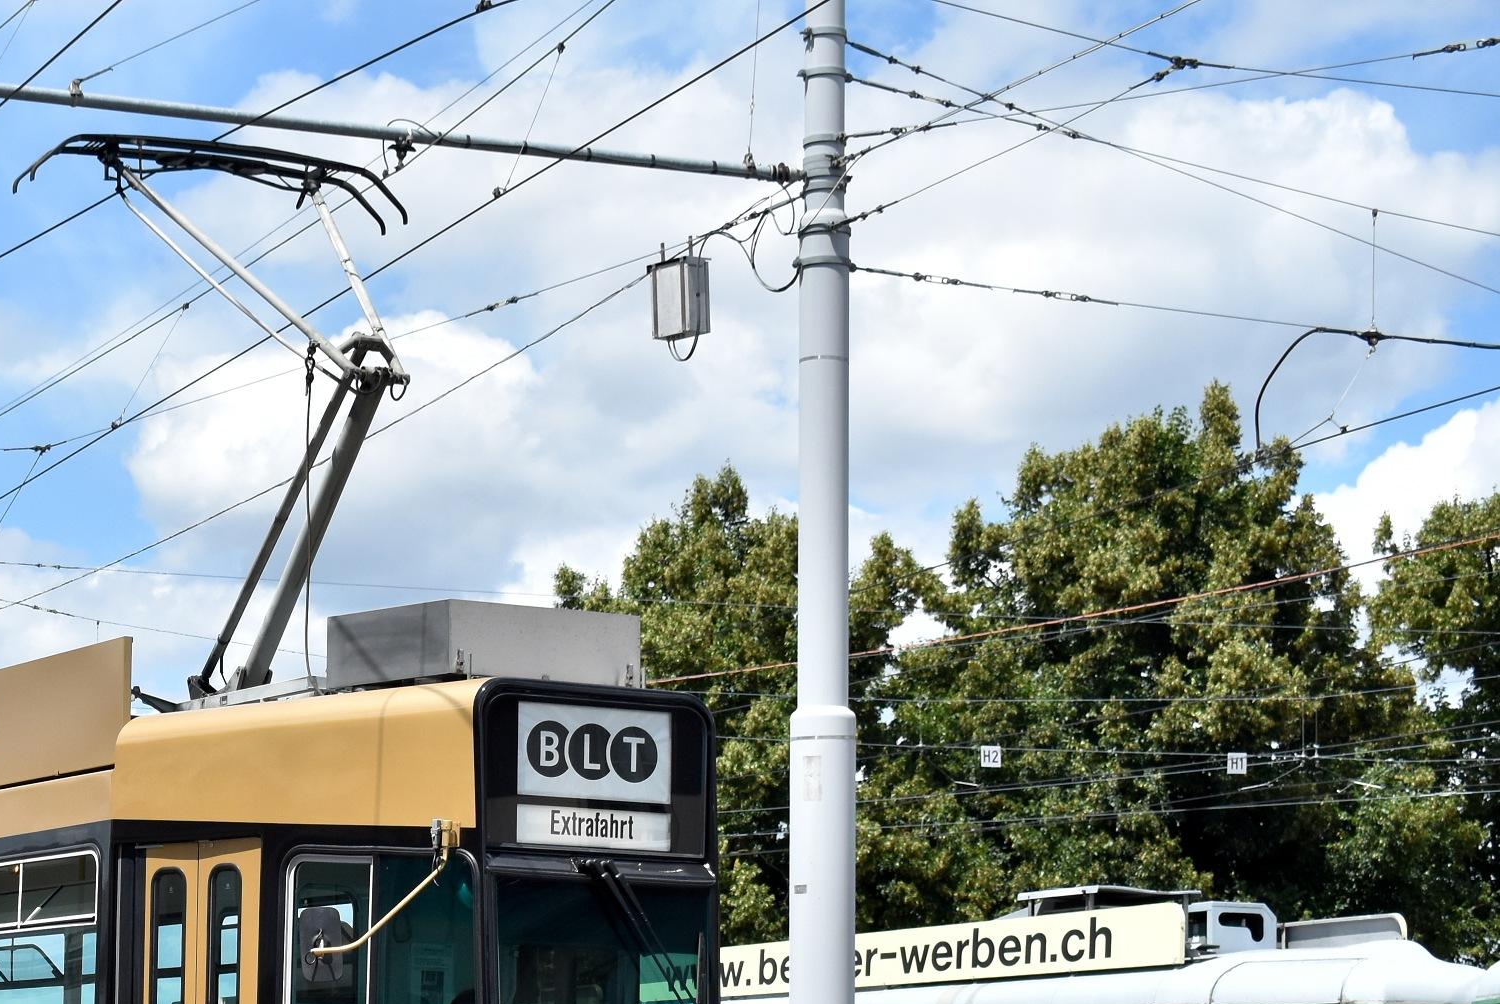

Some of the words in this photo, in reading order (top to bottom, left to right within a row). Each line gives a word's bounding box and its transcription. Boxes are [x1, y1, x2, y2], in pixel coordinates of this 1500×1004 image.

[533, 726, 651, 778] BLT
[983, 751, 999, 764] H2
[1230, 758, 1244, 770] H1
[550, 810, 634, 839] Extrafahrt
